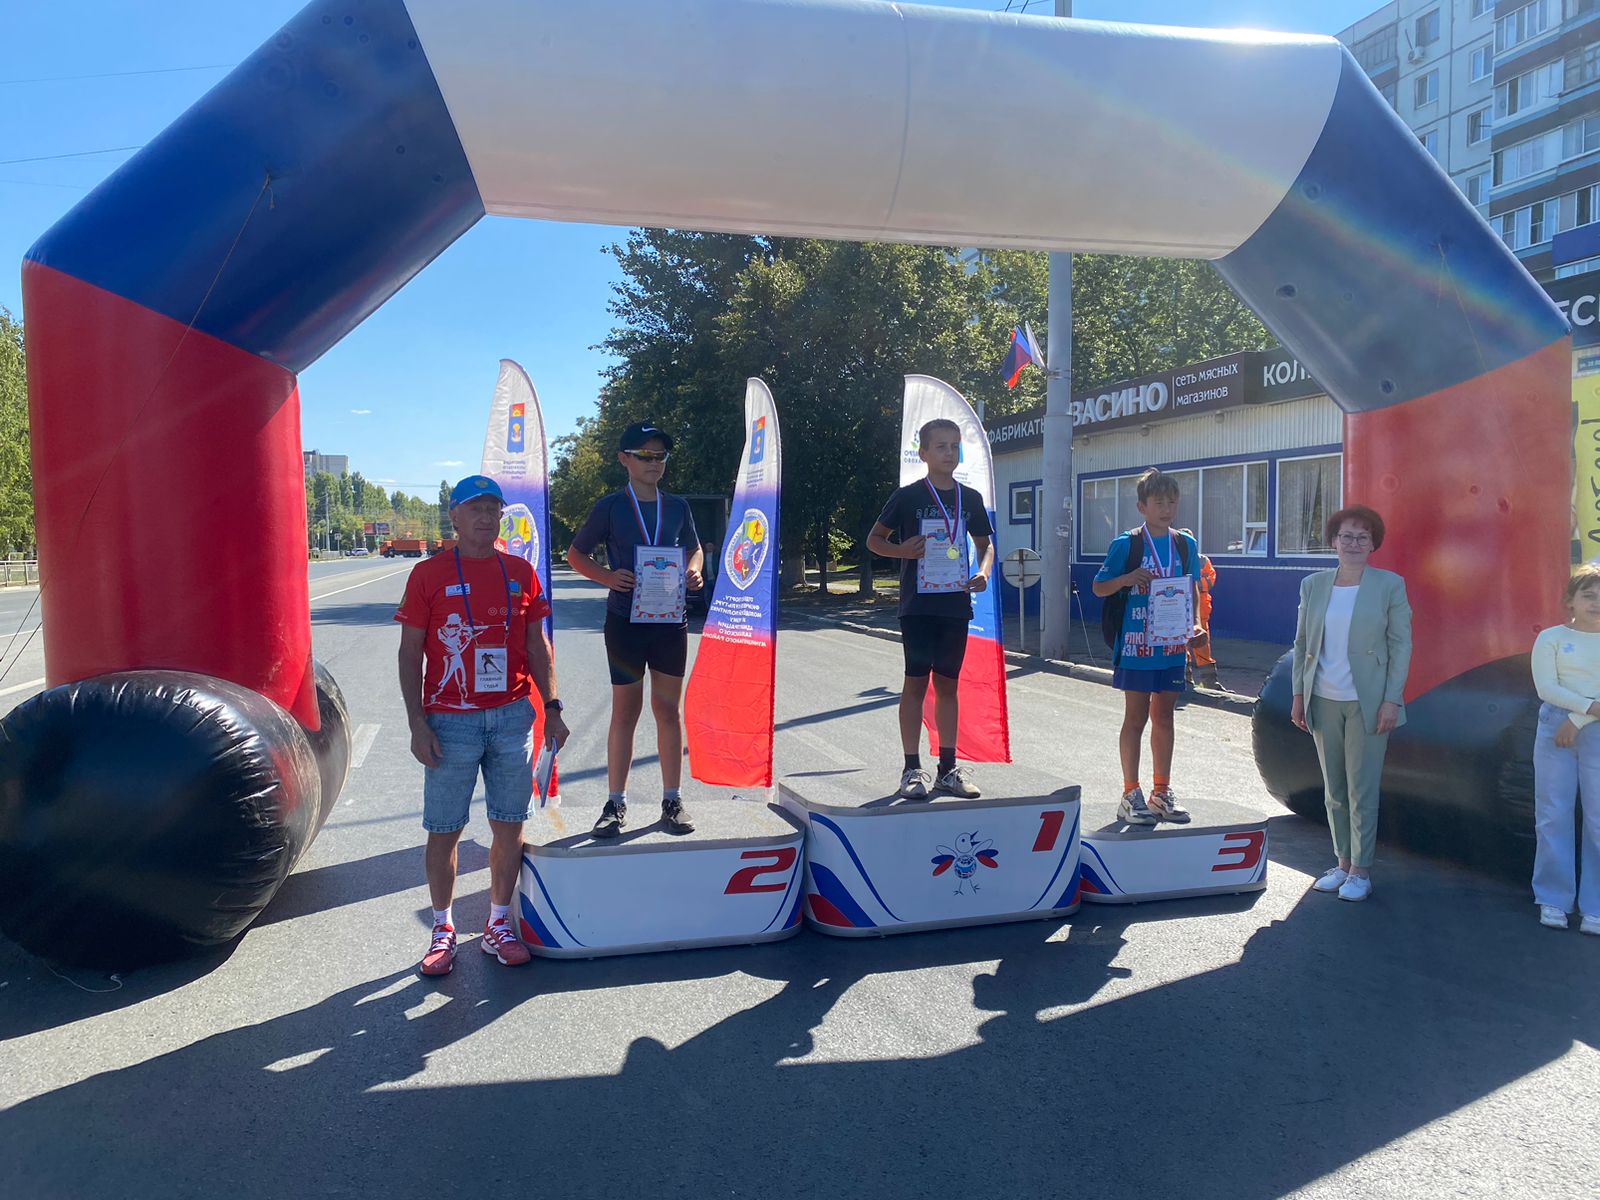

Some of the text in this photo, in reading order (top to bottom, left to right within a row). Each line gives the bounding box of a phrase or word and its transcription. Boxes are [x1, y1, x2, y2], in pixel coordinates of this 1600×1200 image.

[1175, 363, 1239, 387] сеть мясных
[1176, 386, 1229, 406] магазинов
[1032, 811, 1065, 852] 1
[1211, 831, 1264, 872] 3
[724, 847, 797, 895] 2
